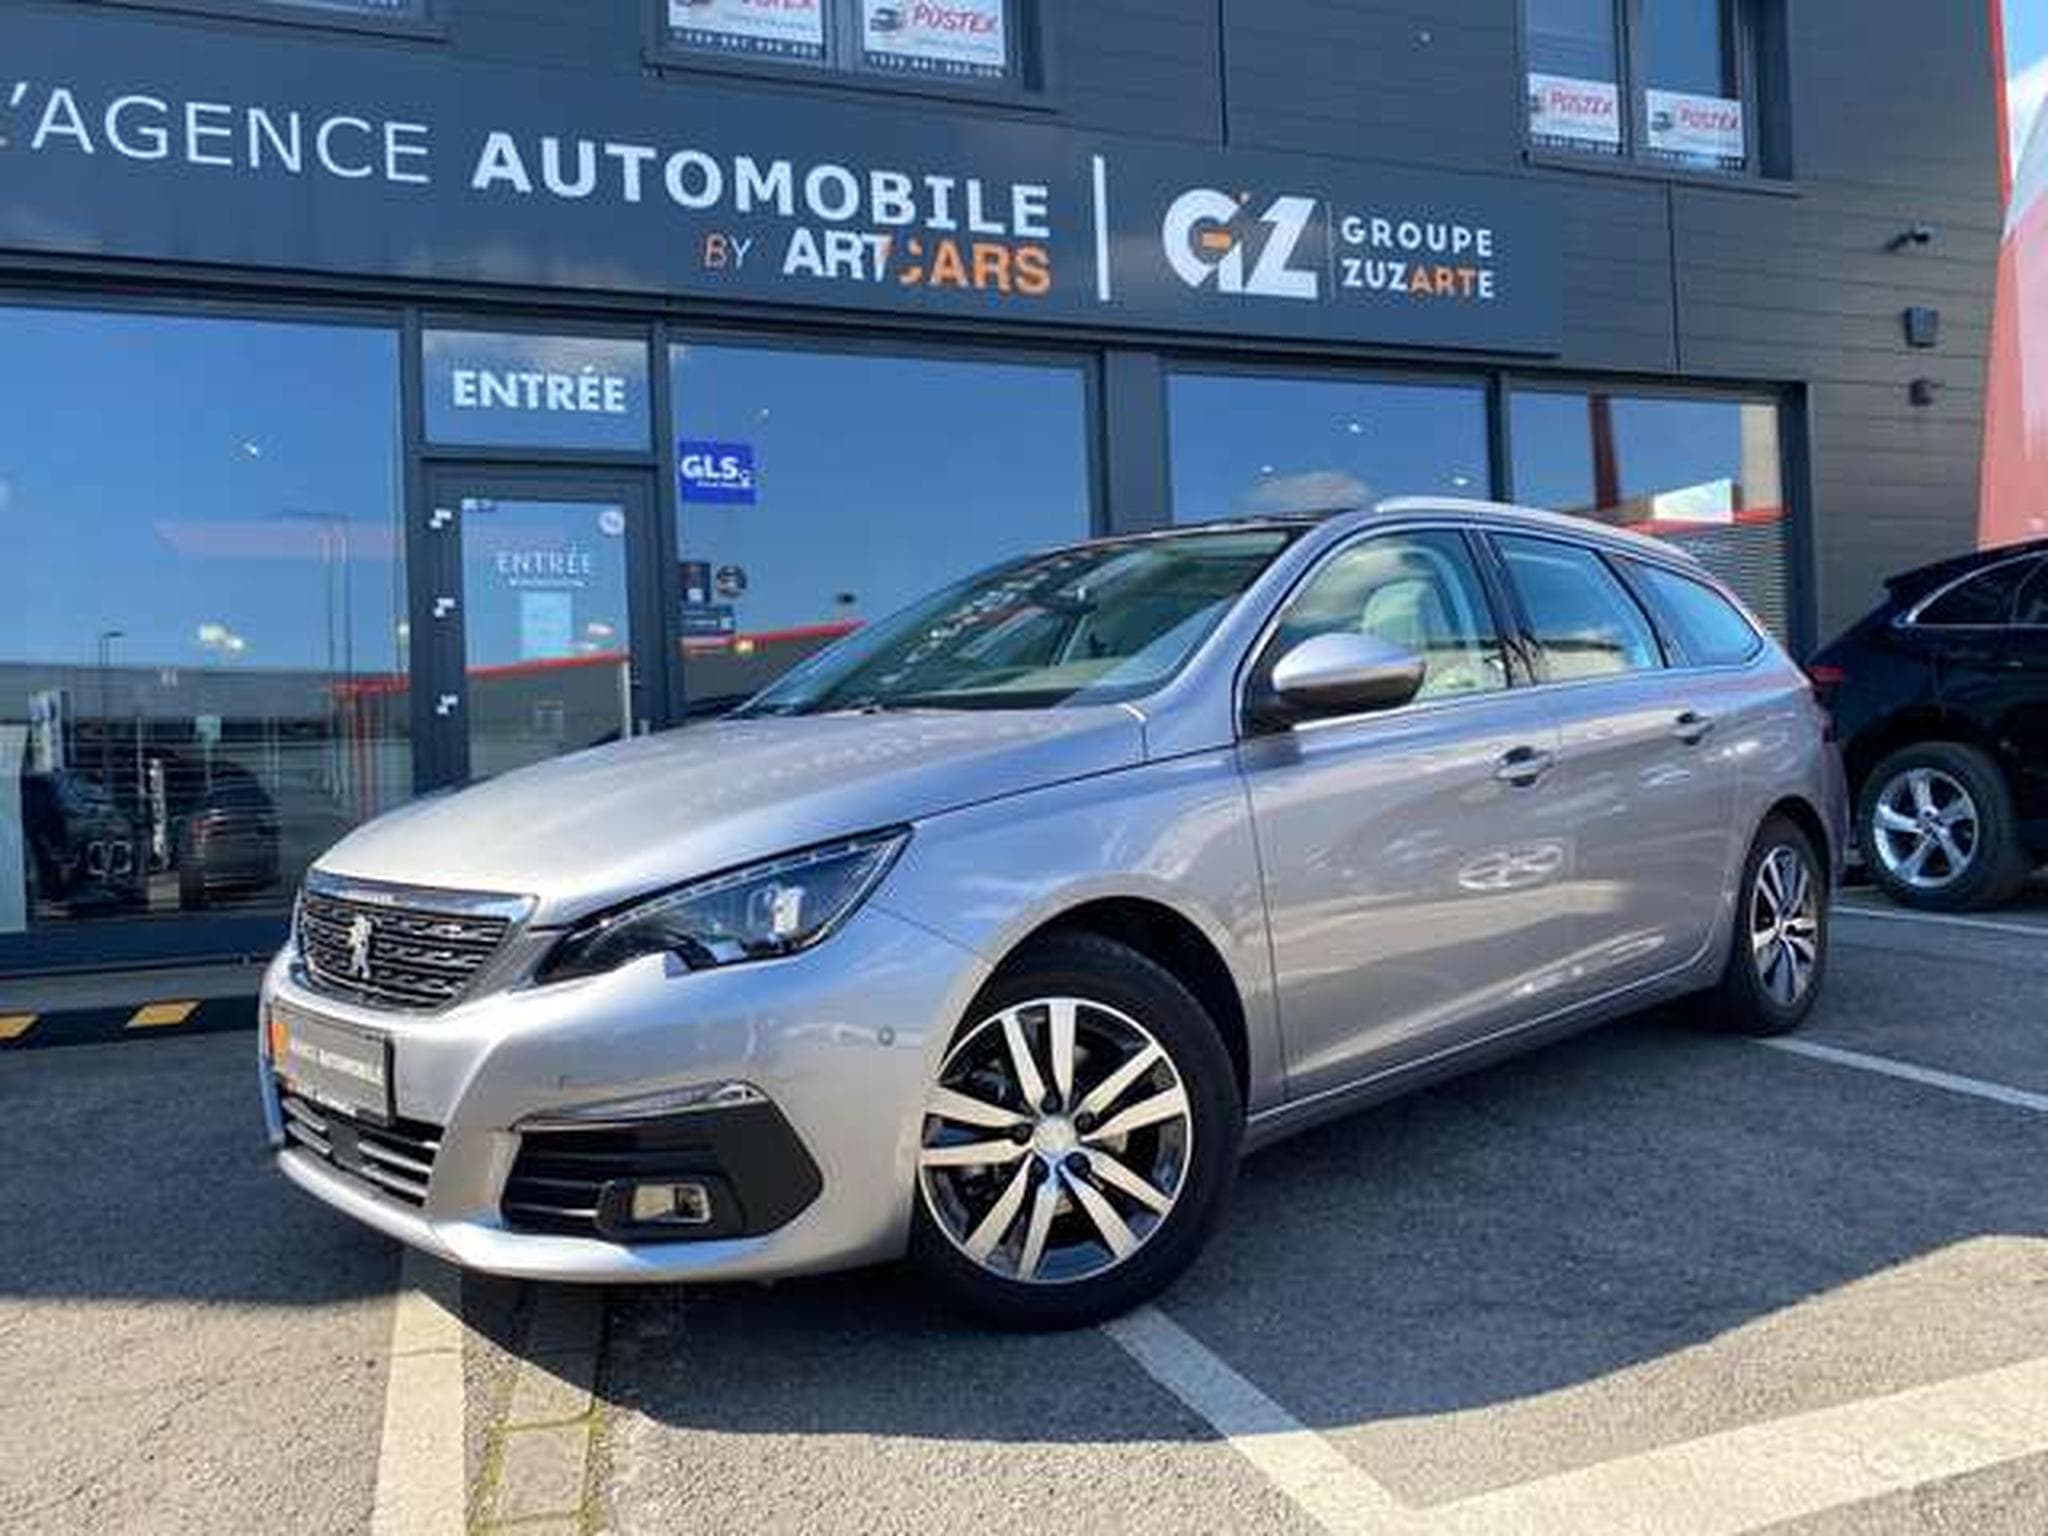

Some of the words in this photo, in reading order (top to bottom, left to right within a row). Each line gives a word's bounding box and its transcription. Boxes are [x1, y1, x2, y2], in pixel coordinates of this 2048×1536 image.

[0, 82, 430, 183] 'AGENCE
[471, 131, 1050, 238] AUTOMOBILE
[704, 233, 752, 269] BY
[1341, 215, 1493, 256] GROUPE
[1341, 258, 1495, 298] ZUZARTE
[453, 365, 626, 412] ENTRÉE
[681, 454, 739, 479] GLS
